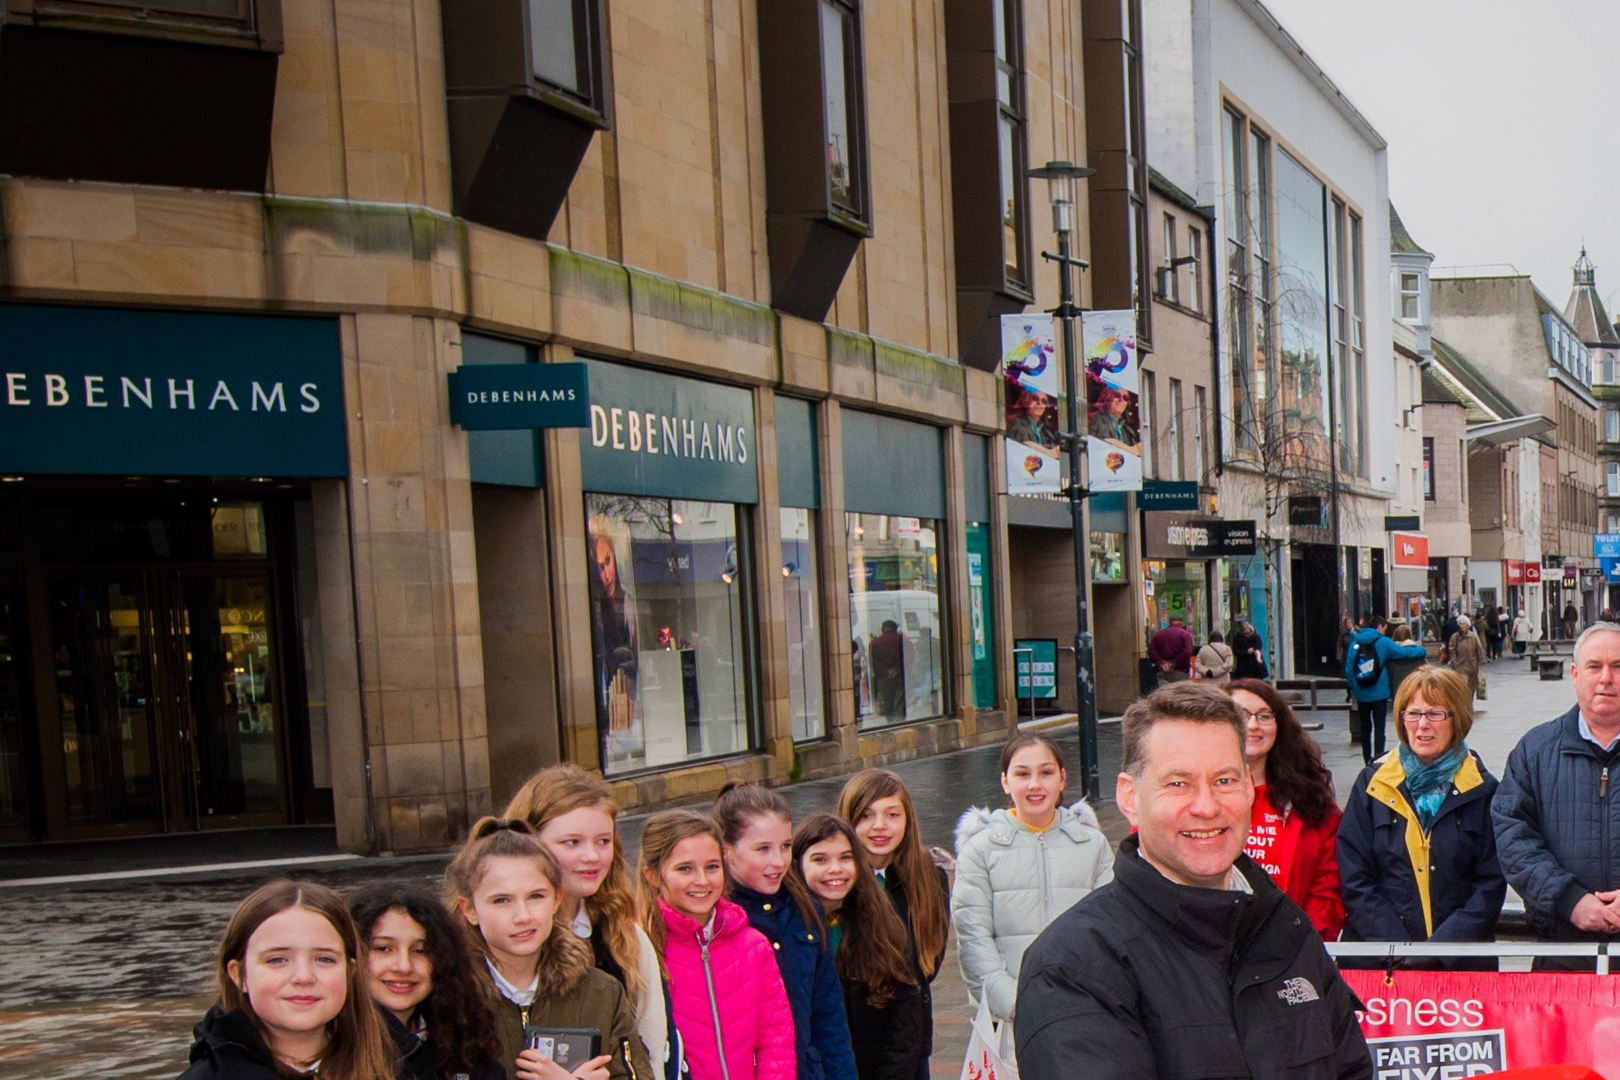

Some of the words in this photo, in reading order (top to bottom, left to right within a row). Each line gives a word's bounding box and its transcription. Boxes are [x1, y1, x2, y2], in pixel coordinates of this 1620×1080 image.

[467, 389, 576, 404] DEBENHAMS
[590, 404, 748, 465] DEBENHAMS
[1256, 826, 1277, 835] ME
[1246, 836, 1275, 847] OUT
[1243, 848, 1266, 860] UR
[1354, 998, 1484, 1027] sness
[1377, 1047, 1420, 1067] FAR
[1427, 1041, 1493, 1063] FROM
